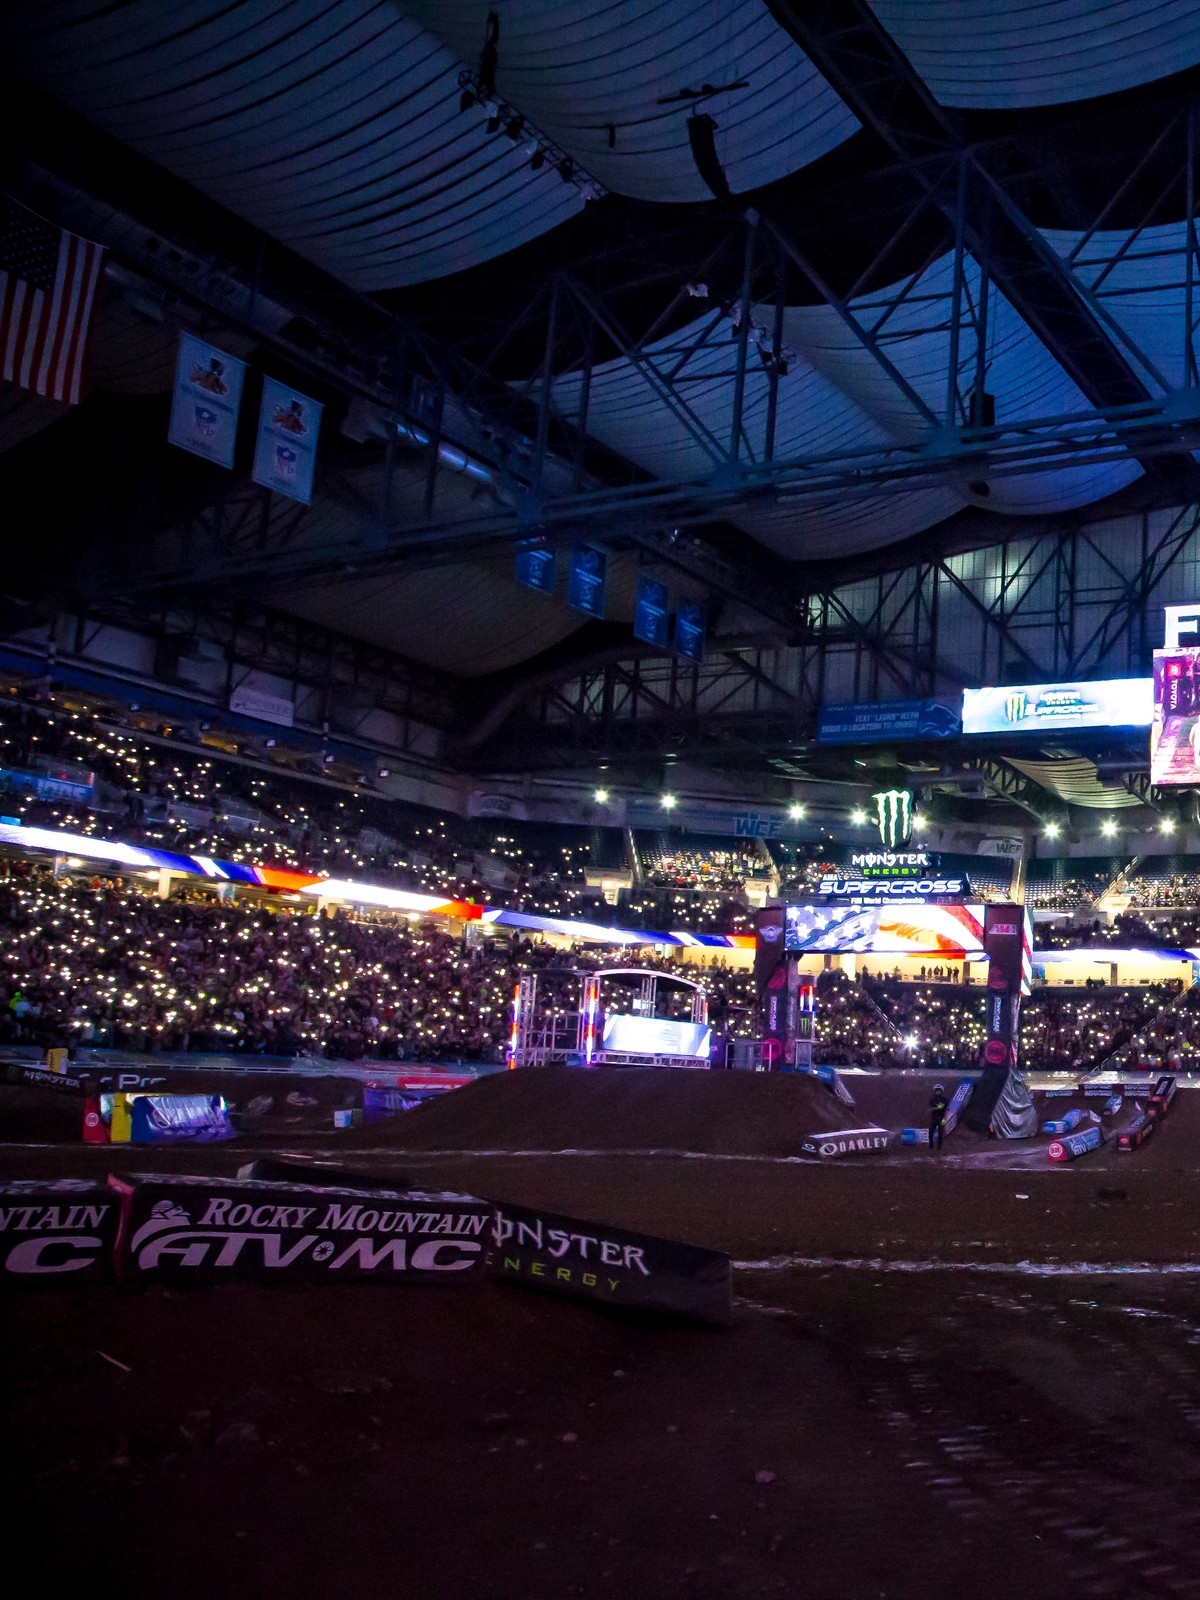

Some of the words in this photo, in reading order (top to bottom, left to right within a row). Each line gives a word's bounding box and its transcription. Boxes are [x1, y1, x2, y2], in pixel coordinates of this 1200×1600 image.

[852, 852, 928, 867] MONSTER
[817, 880, 964, 894] SUPERCROSS
[23, 1070, 81, 1089] MONSTER
[839, 1137, 888, 1153] OAKLEY
[197, 1198, 317, 1229] ROCKY
[316, 1204, 490, 1235] MOUNTAIN
[491, 1210, 651, 1276] ONSTER
